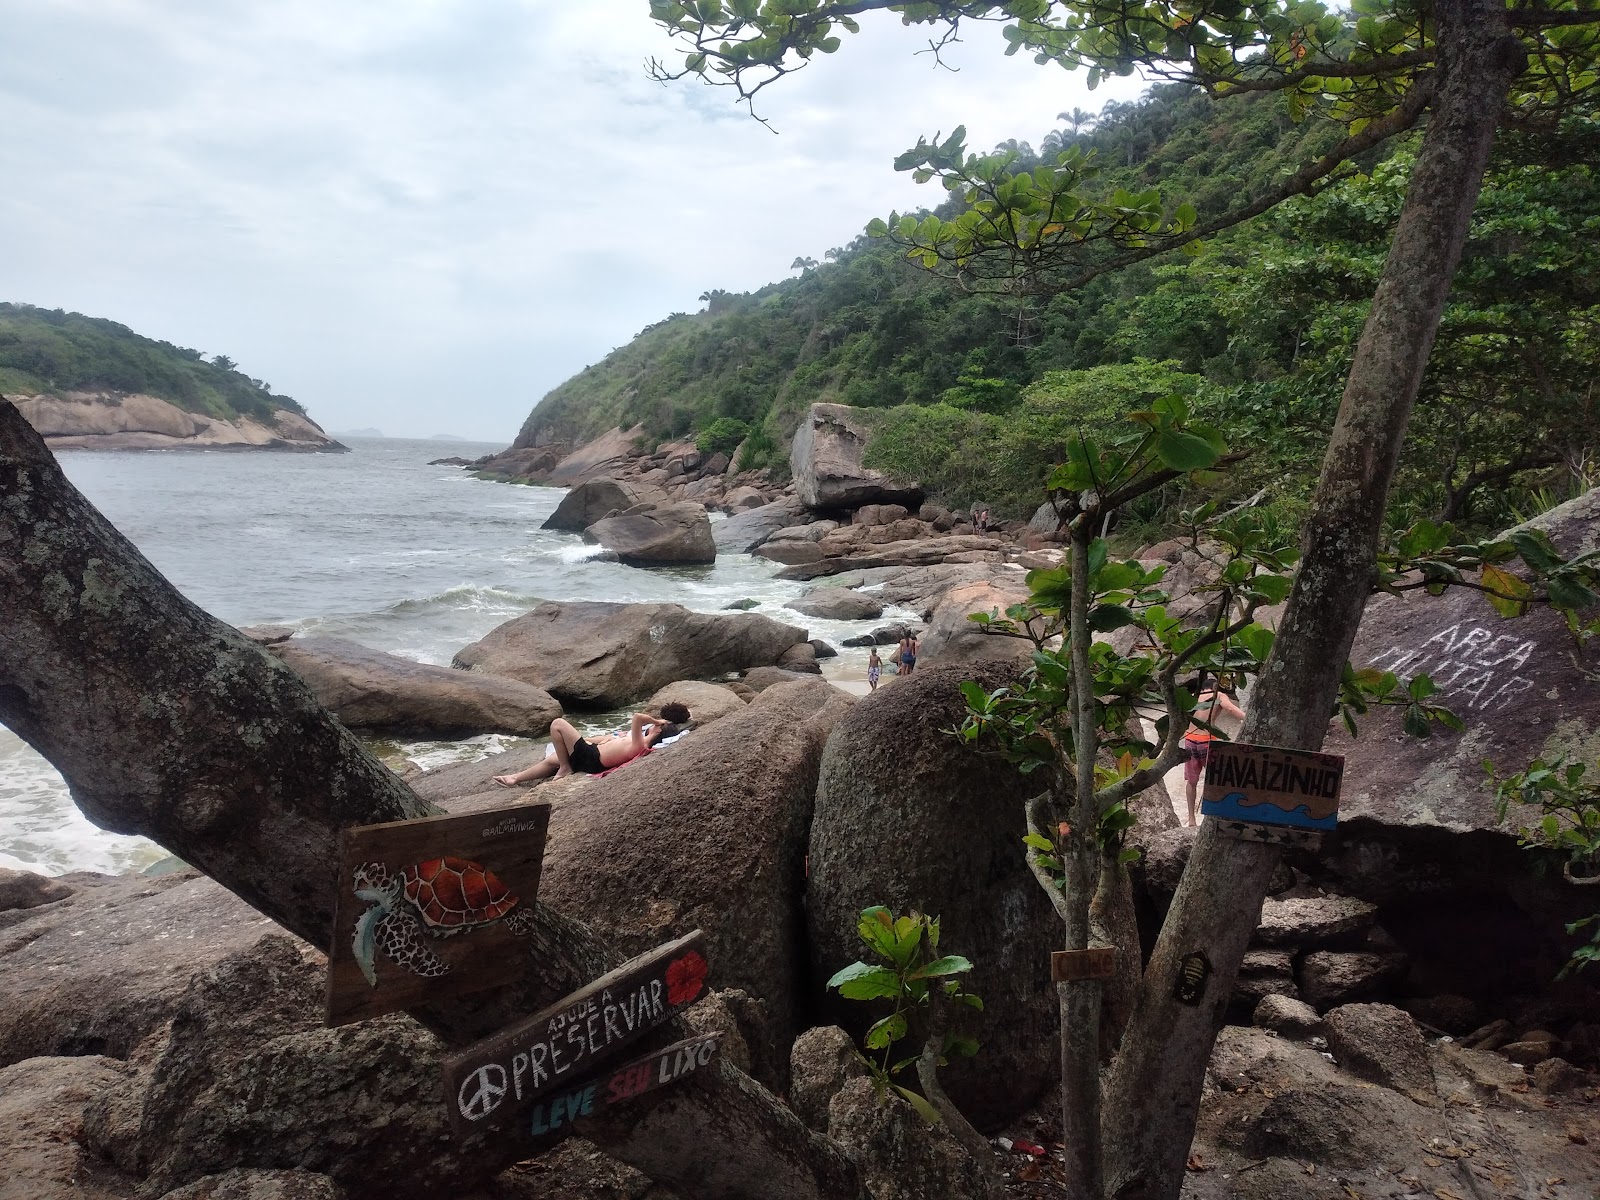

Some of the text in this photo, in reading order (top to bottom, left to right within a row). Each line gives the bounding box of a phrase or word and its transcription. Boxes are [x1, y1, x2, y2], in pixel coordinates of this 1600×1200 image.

[512, 978, 665, 1101] PRESERVAR
[547, 999, 598, 1034] AJUDE
[530, 1038, 718, 1136] LEVE SEU LIXO
